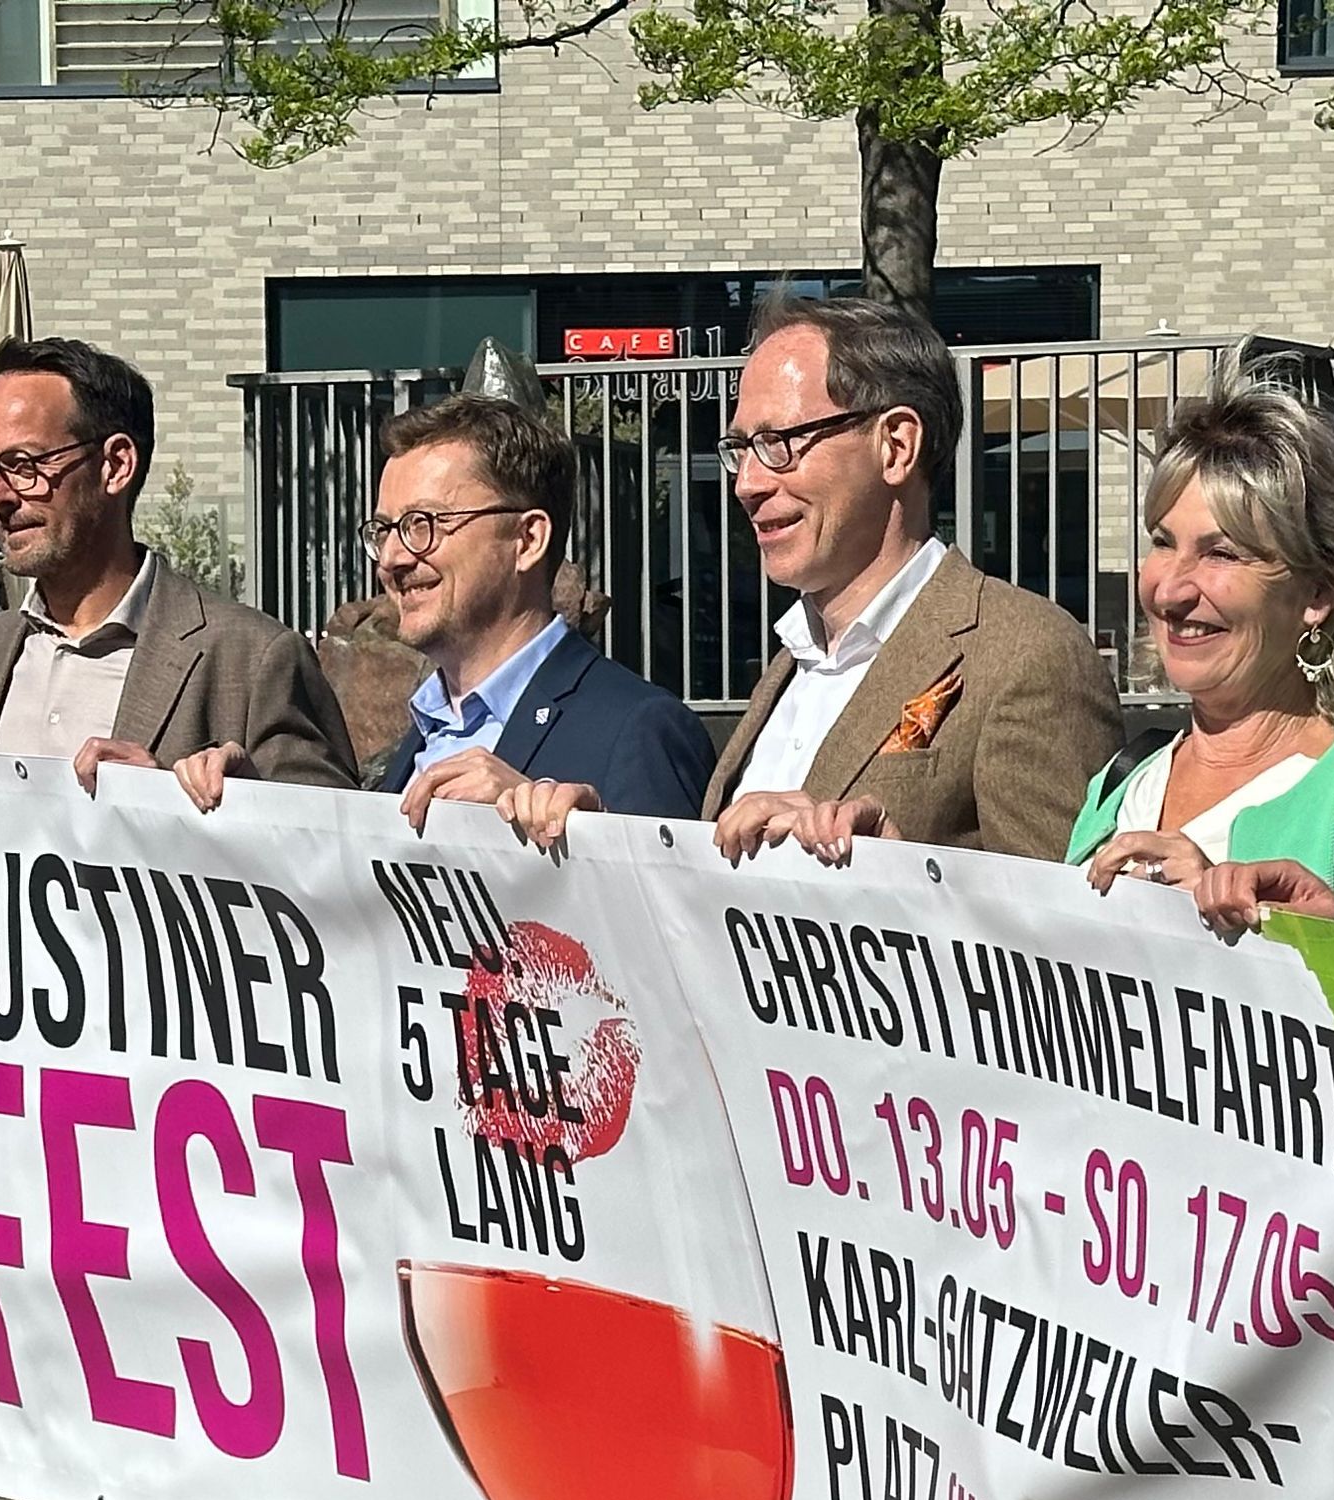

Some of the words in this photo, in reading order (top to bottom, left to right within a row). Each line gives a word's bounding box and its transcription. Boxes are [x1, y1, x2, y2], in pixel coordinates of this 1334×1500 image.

[568, 333, 671, 351] CAFE
[725, 906, 957, 1057] CHRISTI
[397, 985, 434, 1102] 5
[440, 991, 585, 1124] TAGE
[434, 1127, 586, 1262] LANG
[766, 1068, 870, 1201] DO.
[874, 1092, 1019, 1250] 13.05
[1044, 1190, 1066, 1216] -
[1083, 1149, 1158, 1305] SO.
[797, 1231, 1301, 1487] KARL-GATZWEILER-
